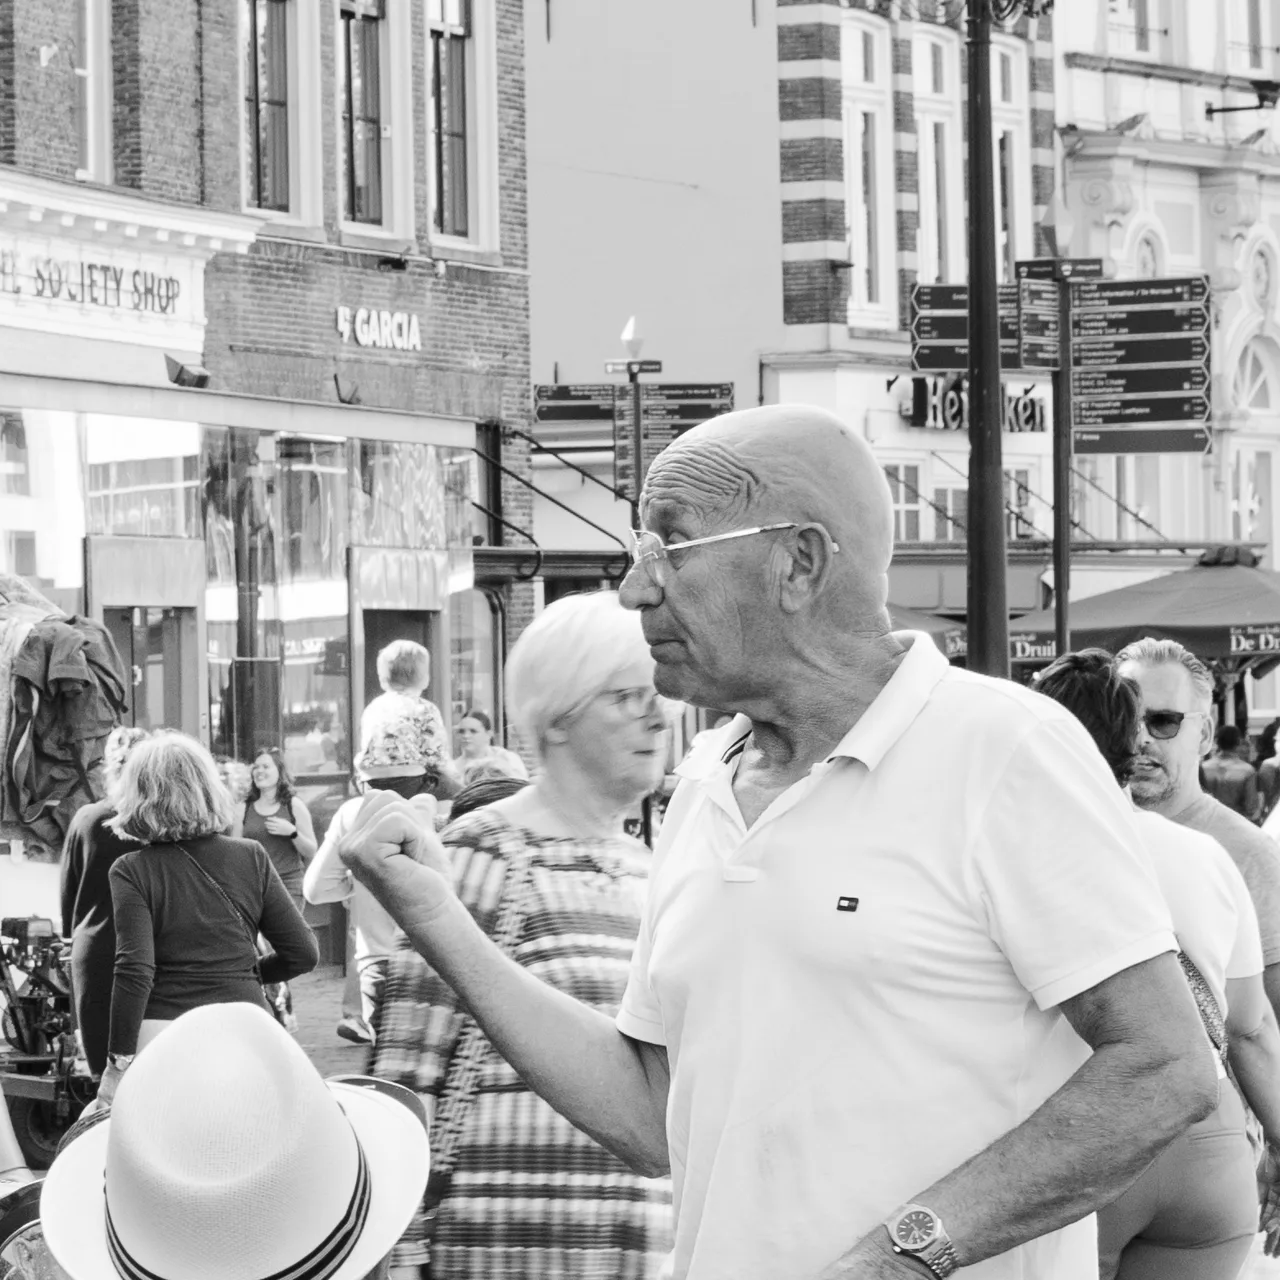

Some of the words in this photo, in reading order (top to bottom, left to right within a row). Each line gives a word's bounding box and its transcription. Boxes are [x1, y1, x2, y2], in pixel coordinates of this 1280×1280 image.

[33, 257, 123, 306] SOCIETY
[132, 269, 180, 313] SHOP
[355, 308, 421, 351] GARCIA
[925, 376, 1047, 433] Heiken
[1230, 635, 1255, 651] De
